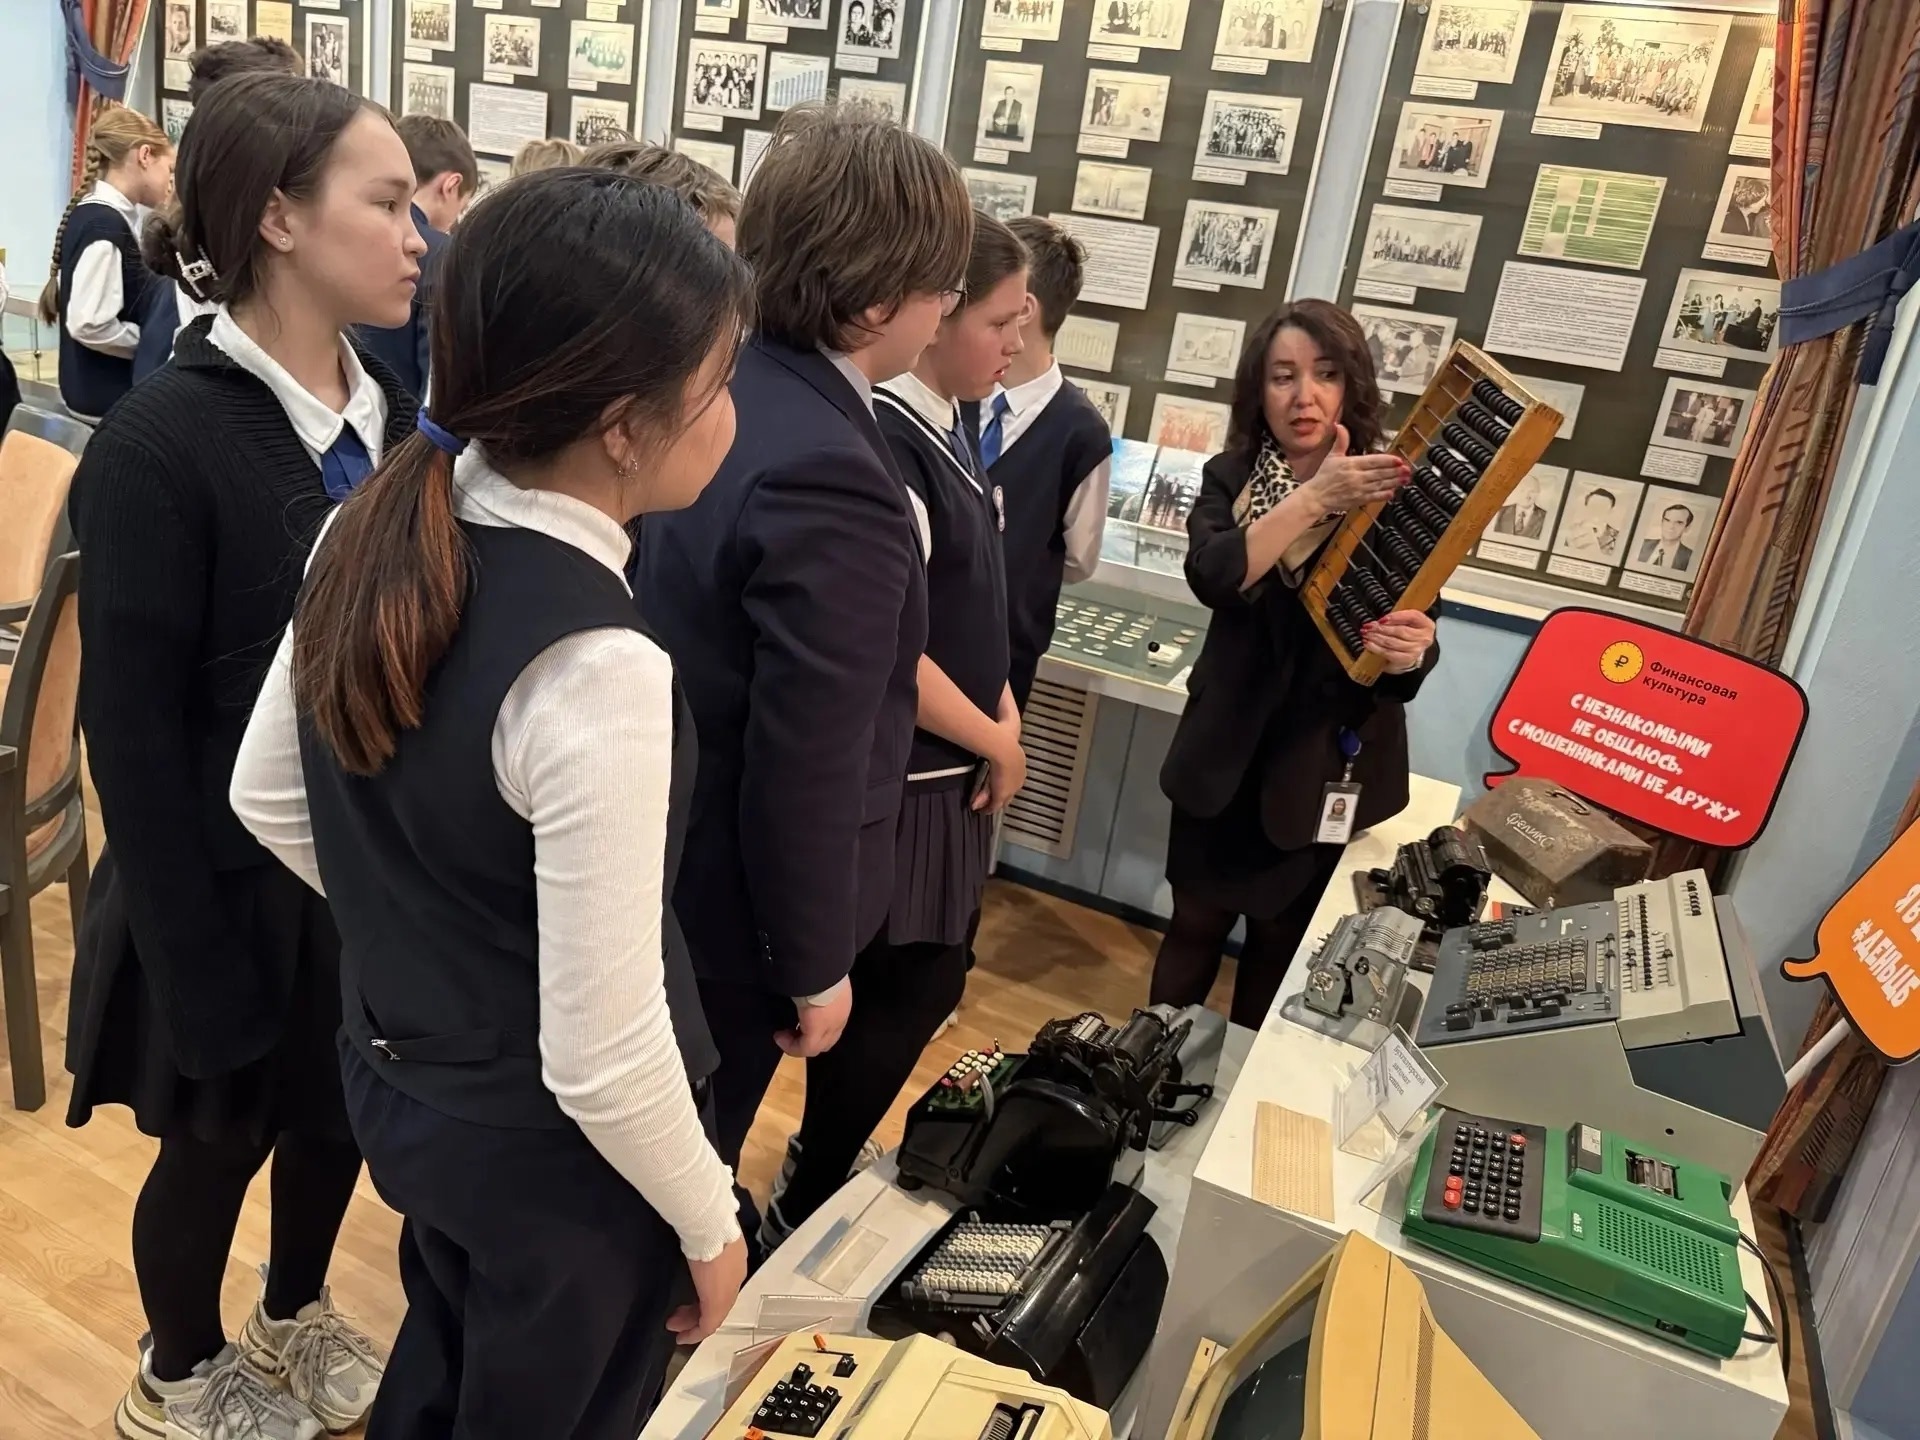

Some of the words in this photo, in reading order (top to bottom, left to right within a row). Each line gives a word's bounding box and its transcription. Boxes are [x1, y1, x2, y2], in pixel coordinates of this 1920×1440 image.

[1642, 676, 1707, 705] культура
[1650, 661, 1738, 701] Финансовая
[1570, 693, 1585, 709] С
[1581, 696, 1713, 759] НЕЗНАКОМЫМИ
[1570, 718, 1597, 738] НЕ
[1593, 728, 1684, 776] ОБЩАЮСЬ,
[1507, 718, 1523, 734] С
[1518, 721, 1645, 785] МОШЕННИКАМИ
[1641, 772, 1669, 795] НЕ
[1664, 785, 1741, 823] ДРУЖУ
[1851, 918, 1920, 1009] #ДЕНЬЦБ
[1393, 1044, 1426, 1086] Бухгалтерский
